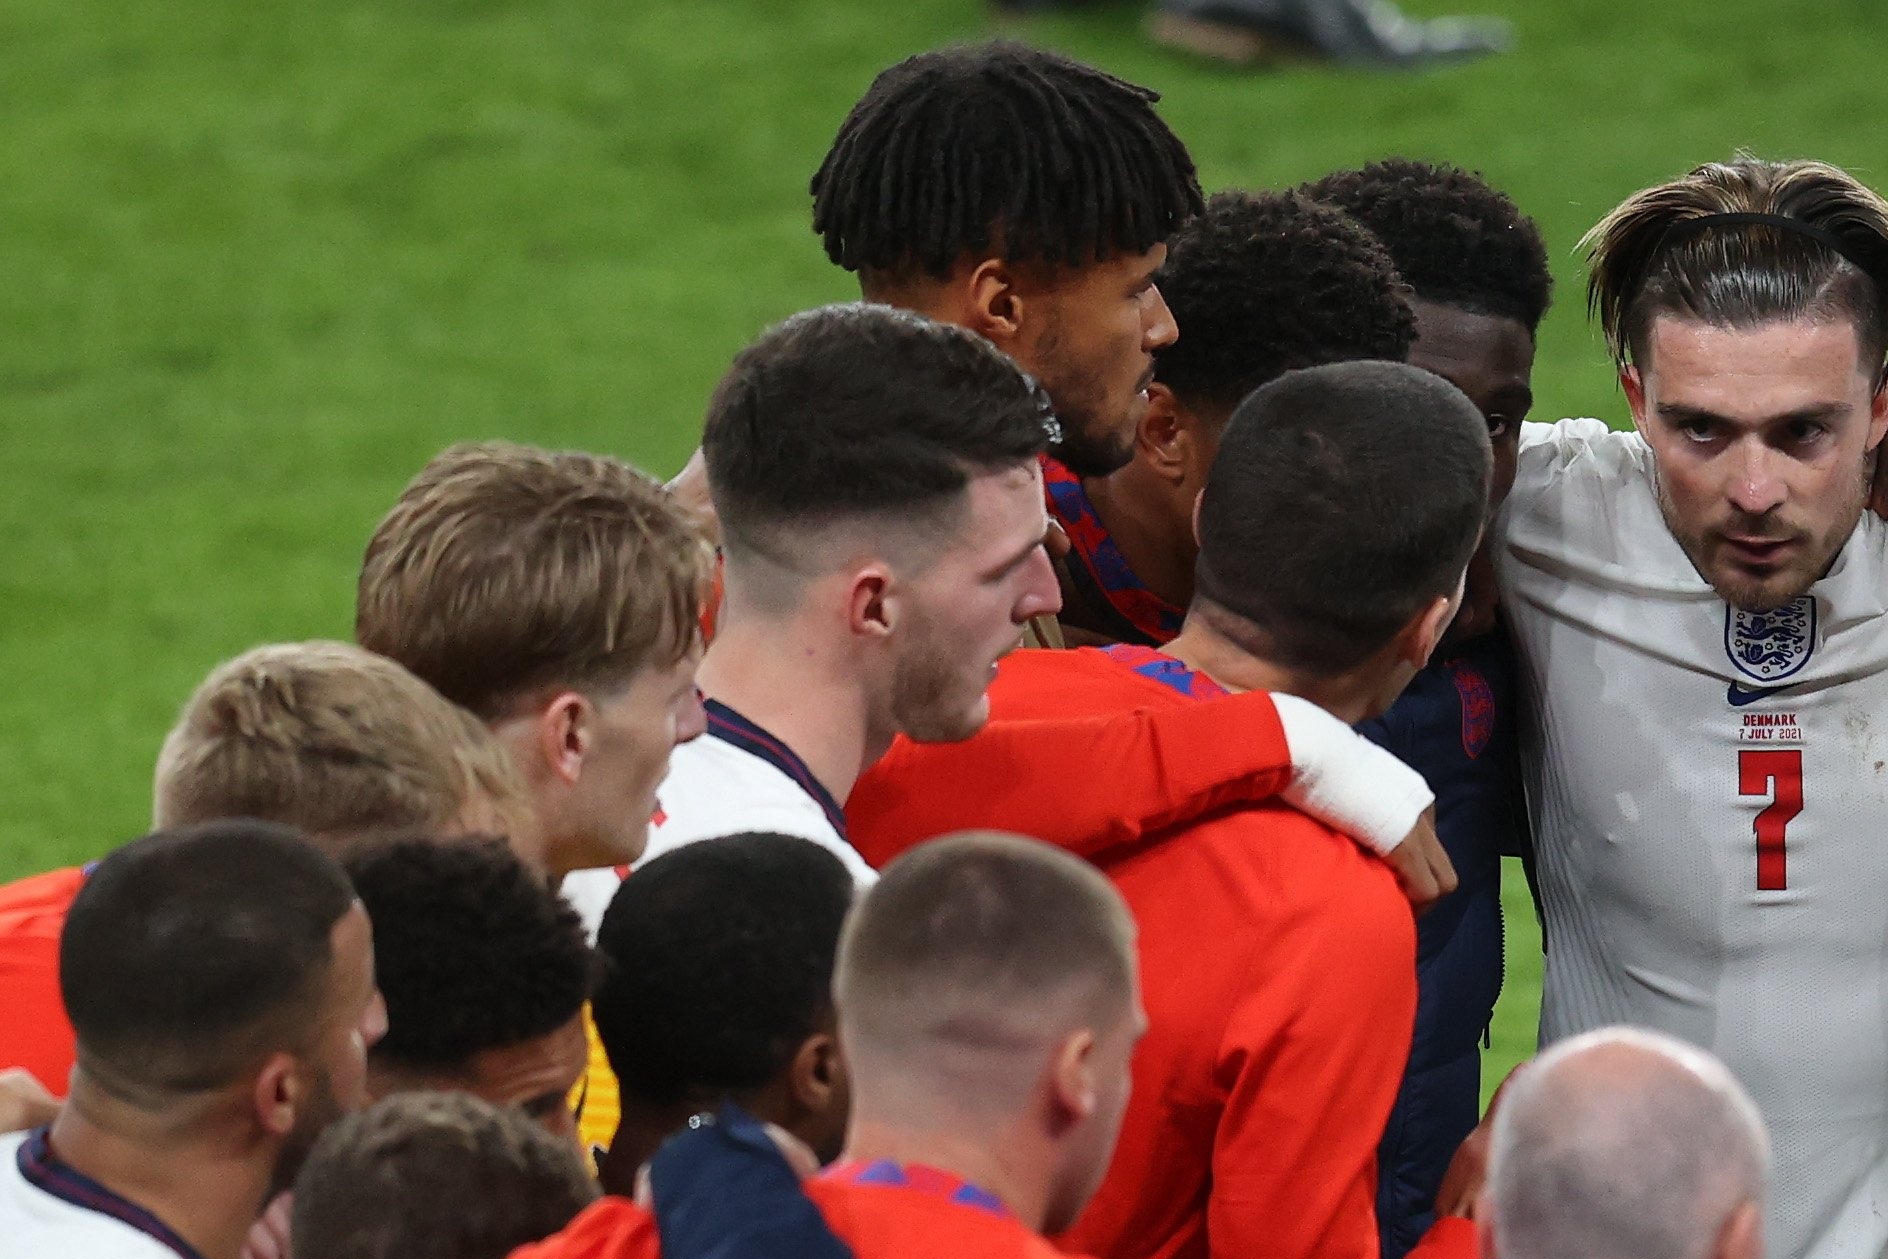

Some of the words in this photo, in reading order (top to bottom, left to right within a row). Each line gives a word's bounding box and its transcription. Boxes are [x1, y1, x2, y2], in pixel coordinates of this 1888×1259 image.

[1743, 714, 1797, 727] DENMARK
[1739, 728, 1745, 739] 7
[1748, 728, 1774, 739] JULY
[1779, 727, 1802, 739] 2021
[1738, 750, 1804, 890] 7
